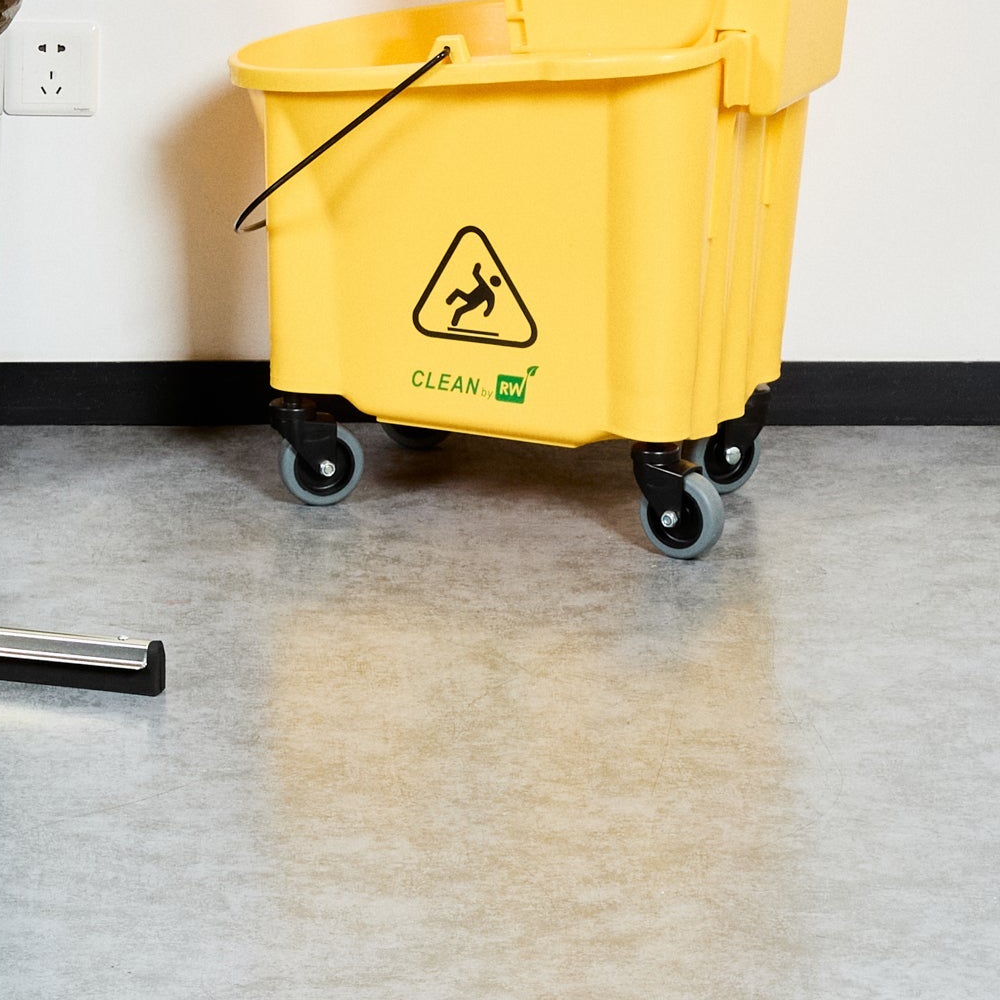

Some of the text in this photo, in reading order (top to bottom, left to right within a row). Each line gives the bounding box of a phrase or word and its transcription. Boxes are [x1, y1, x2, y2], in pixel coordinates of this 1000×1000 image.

[411, 370, 526, 400] CLEAN by RW
